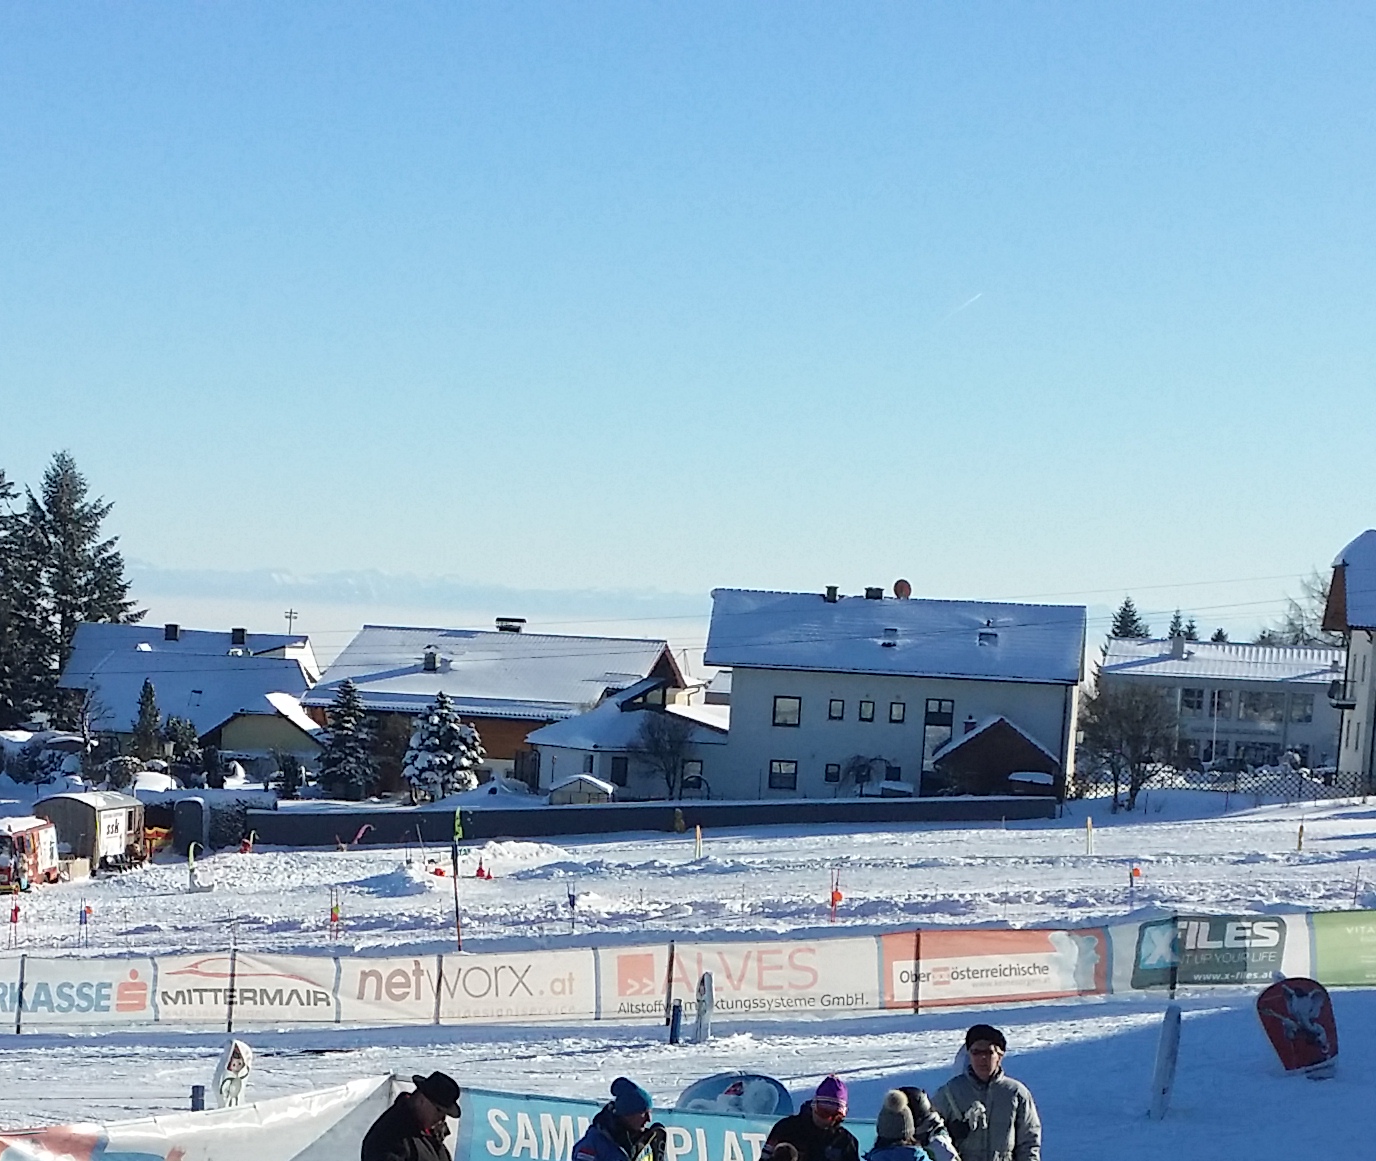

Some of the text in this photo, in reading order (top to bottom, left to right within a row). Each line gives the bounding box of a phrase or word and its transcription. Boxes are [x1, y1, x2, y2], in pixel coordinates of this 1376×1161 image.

[1252, 951, 1278, 963] LIFE
[661, 947, 820, 993] ALVES
[899, 962, 1050, 984] Ober österreichische
[1193, 971, 1273, 981] www.x-files.at
[161, 988, 332, 1007] MITTERMAIR
